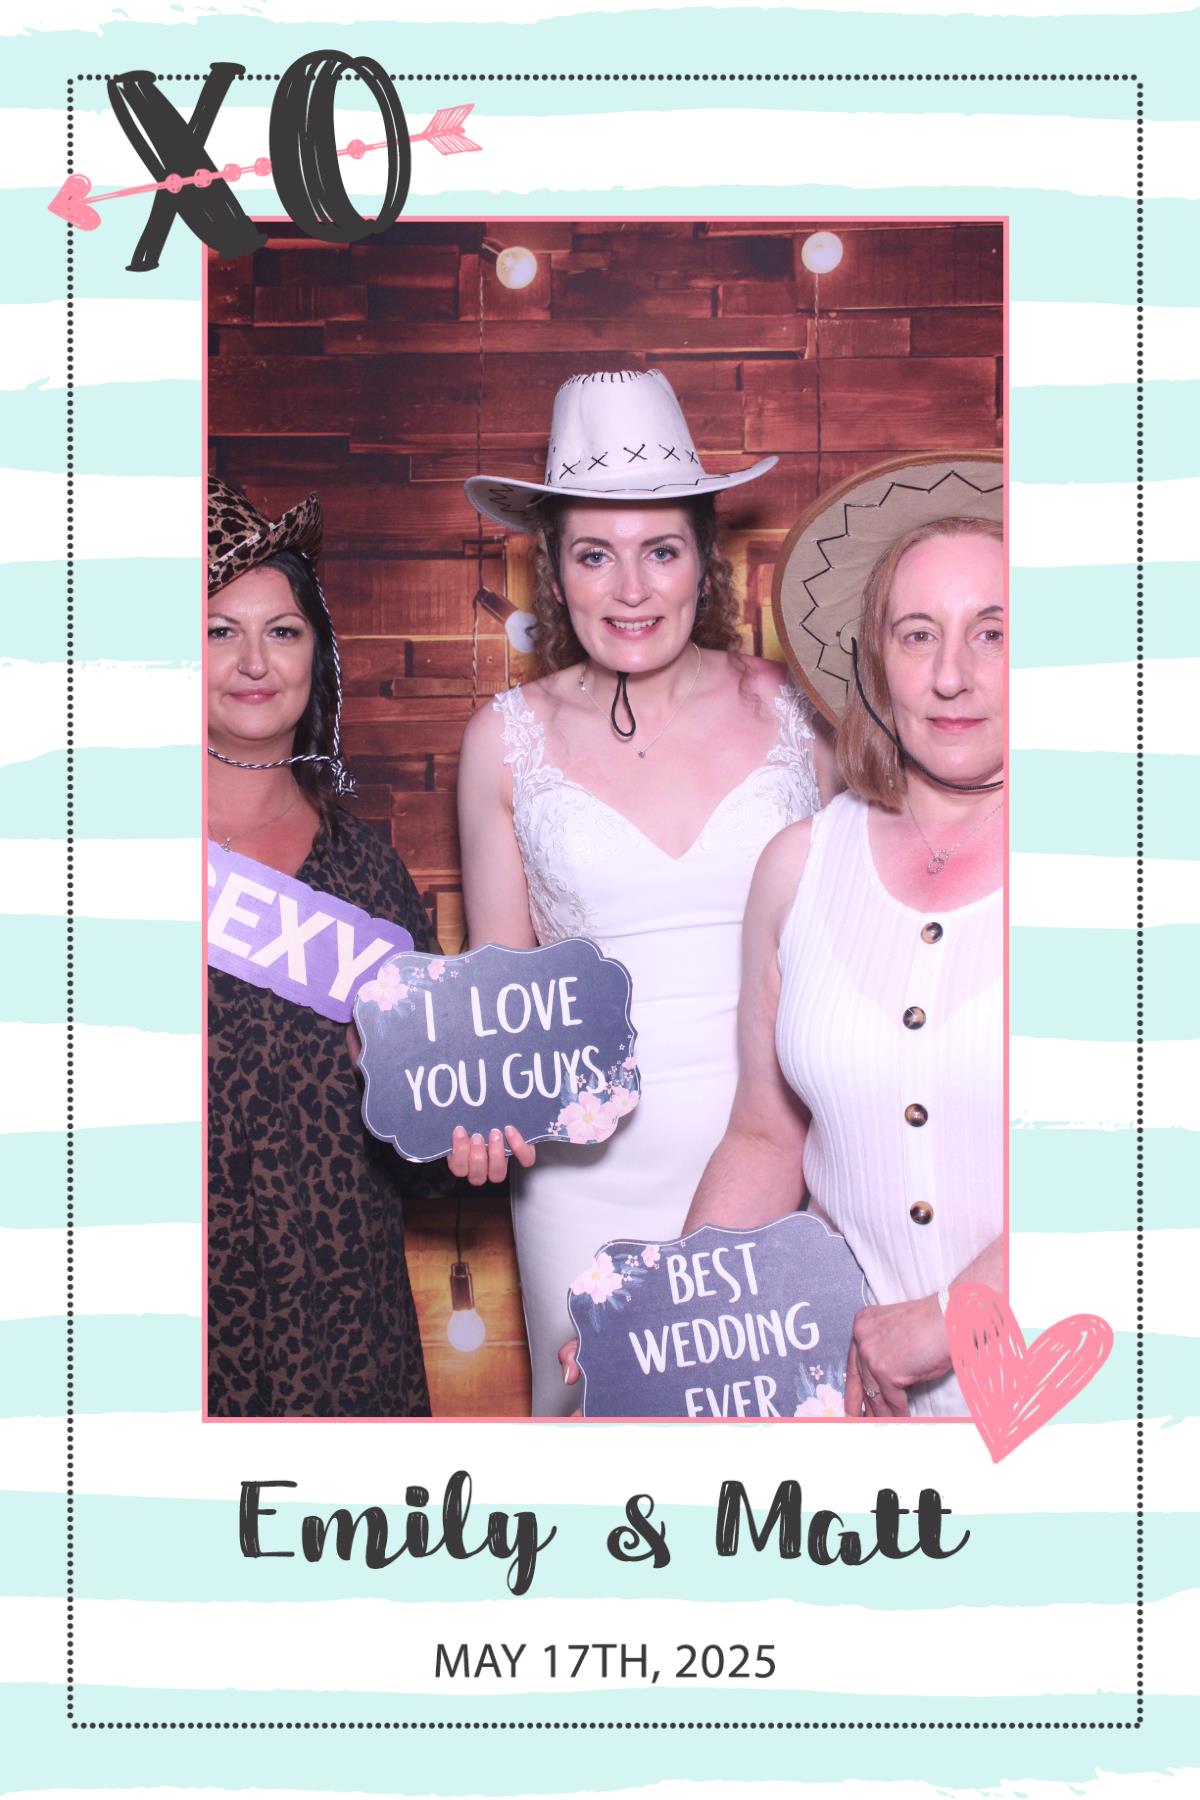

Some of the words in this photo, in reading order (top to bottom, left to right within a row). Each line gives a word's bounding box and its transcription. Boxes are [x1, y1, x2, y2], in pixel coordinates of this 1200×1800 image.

[208, 862, 395, 1003] EXY
[424, 990, 436, 1042] I
[470, 976, 583, 1038] LOVE
[405, 1058, 487, 1112] YOU
[502, 1045, 606, 1099] GUYS
[666, 1242, 757, 1305] BEST
[629, 1301, 820, 1375] WEDDING
